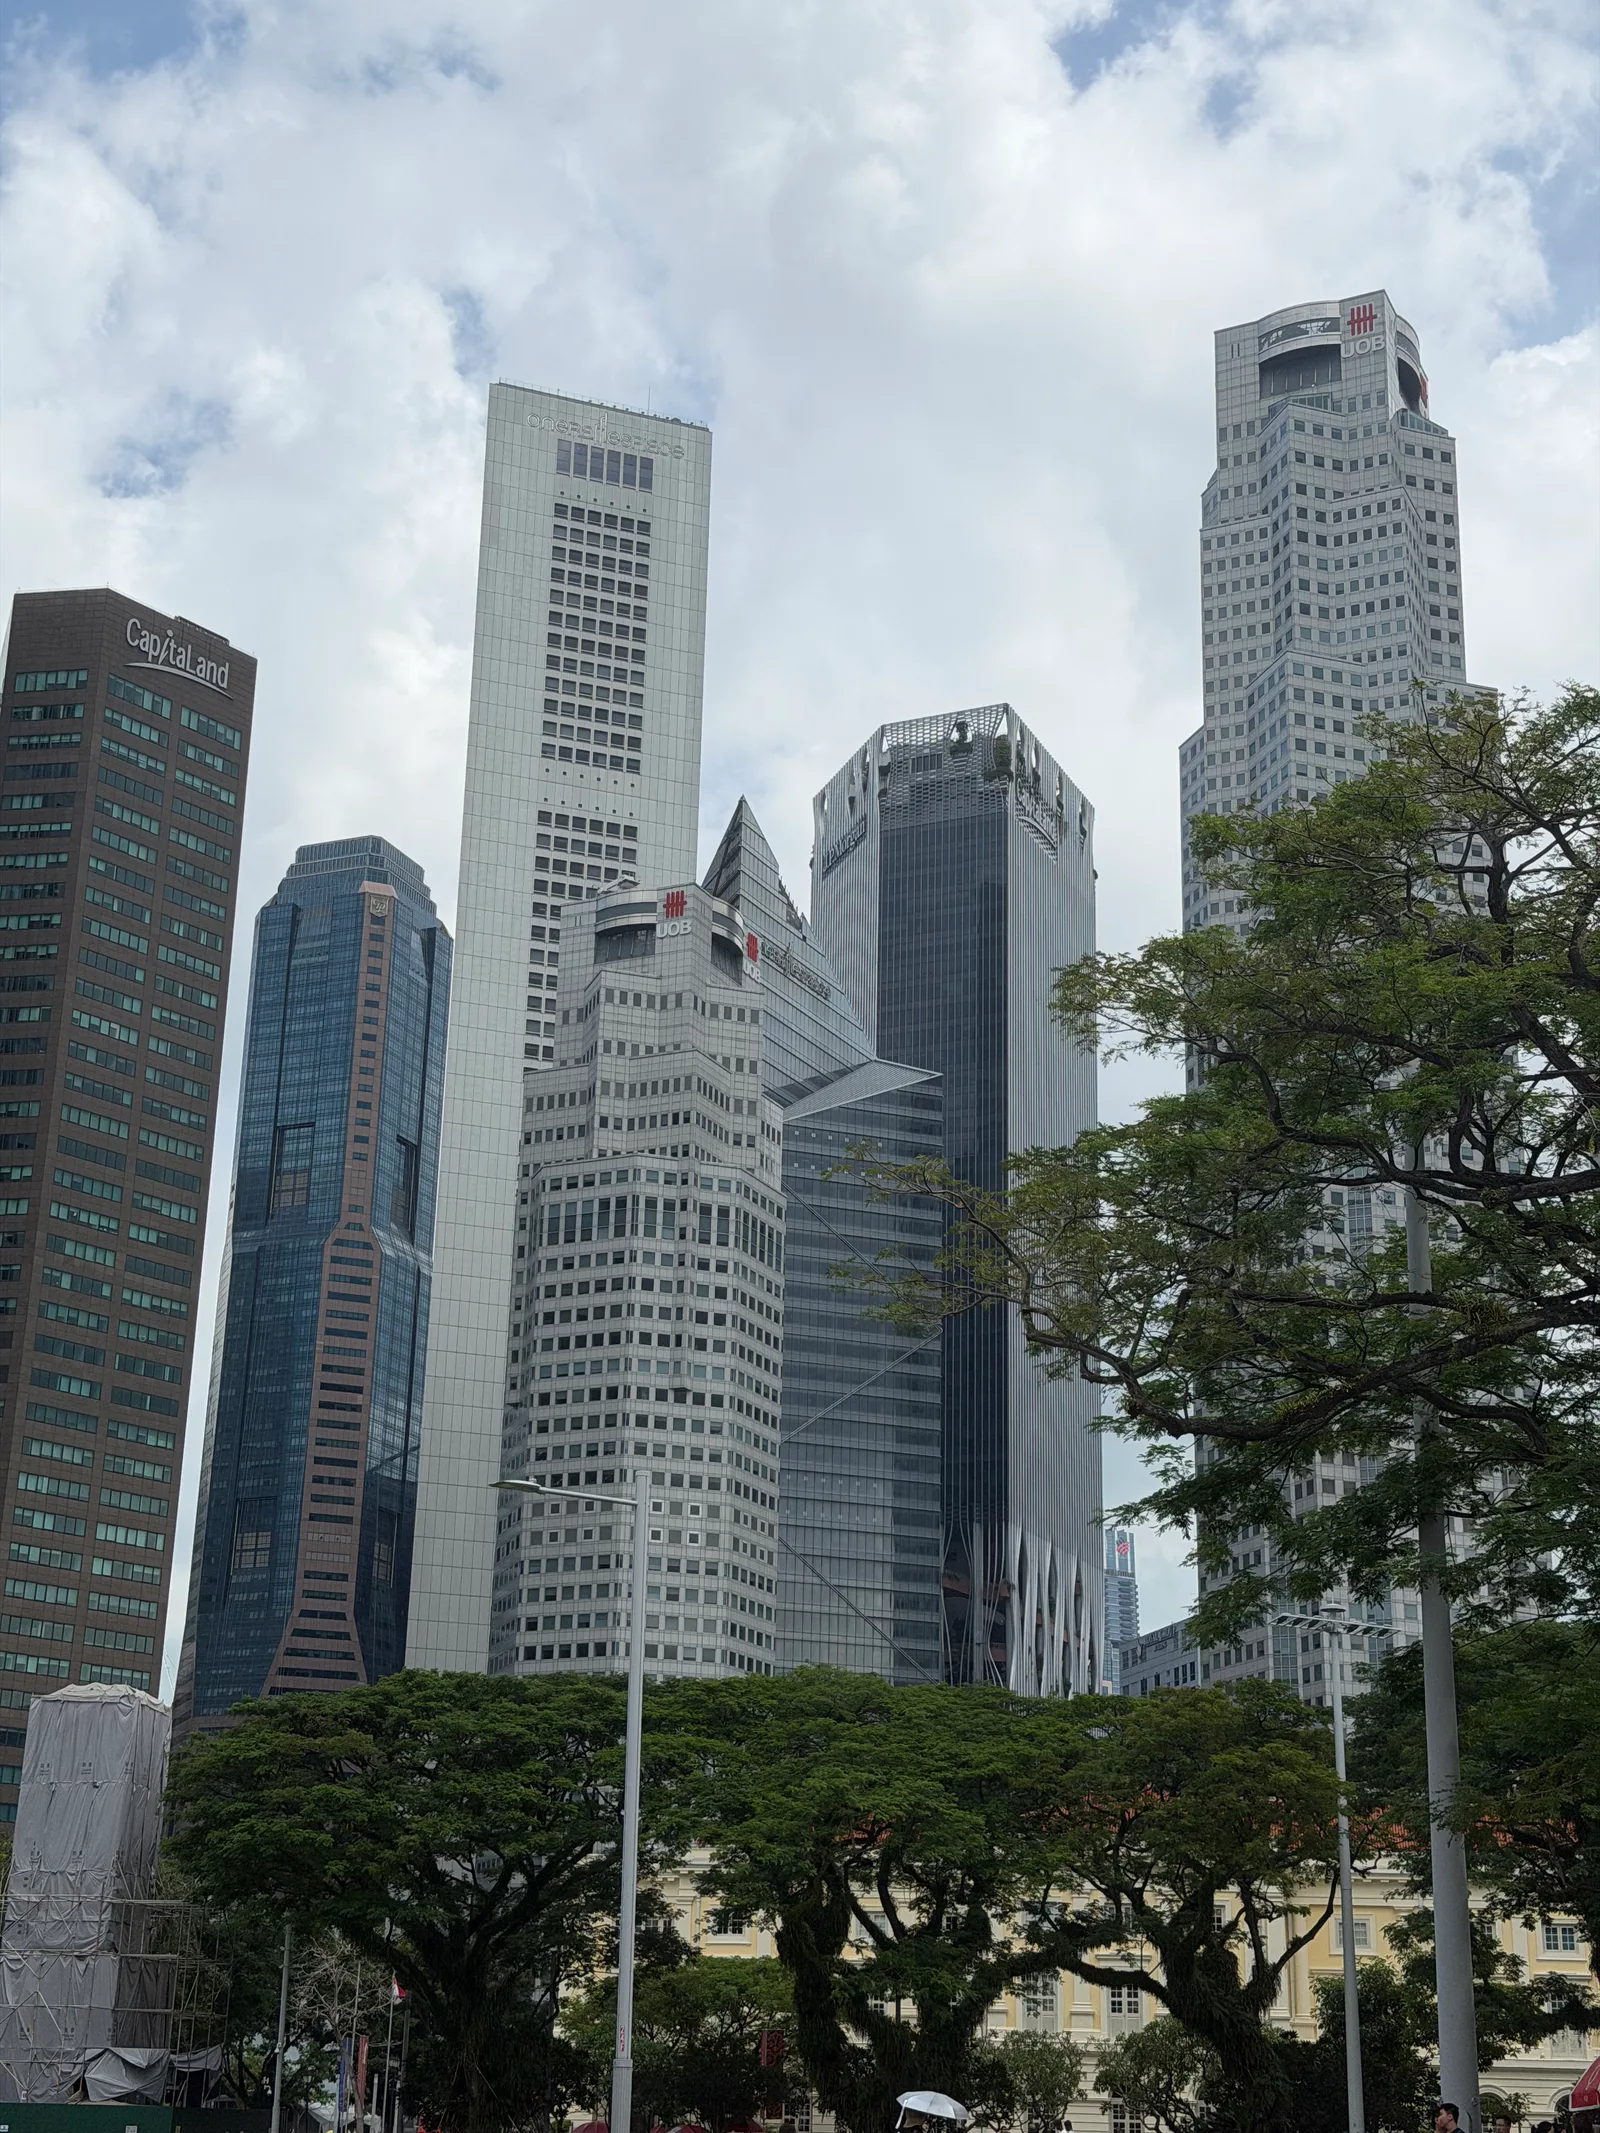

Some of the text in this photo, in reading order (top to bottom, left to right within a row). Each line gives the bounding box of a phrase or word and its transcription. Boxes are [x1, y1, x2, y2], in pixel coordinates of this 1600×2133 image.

[1341, 335, 1386, 359] UOB
[126, 618, 230, 690] CapitaLand
[656, 920, 692, 939] UOB
[743, 961, 761, 985] UOB
